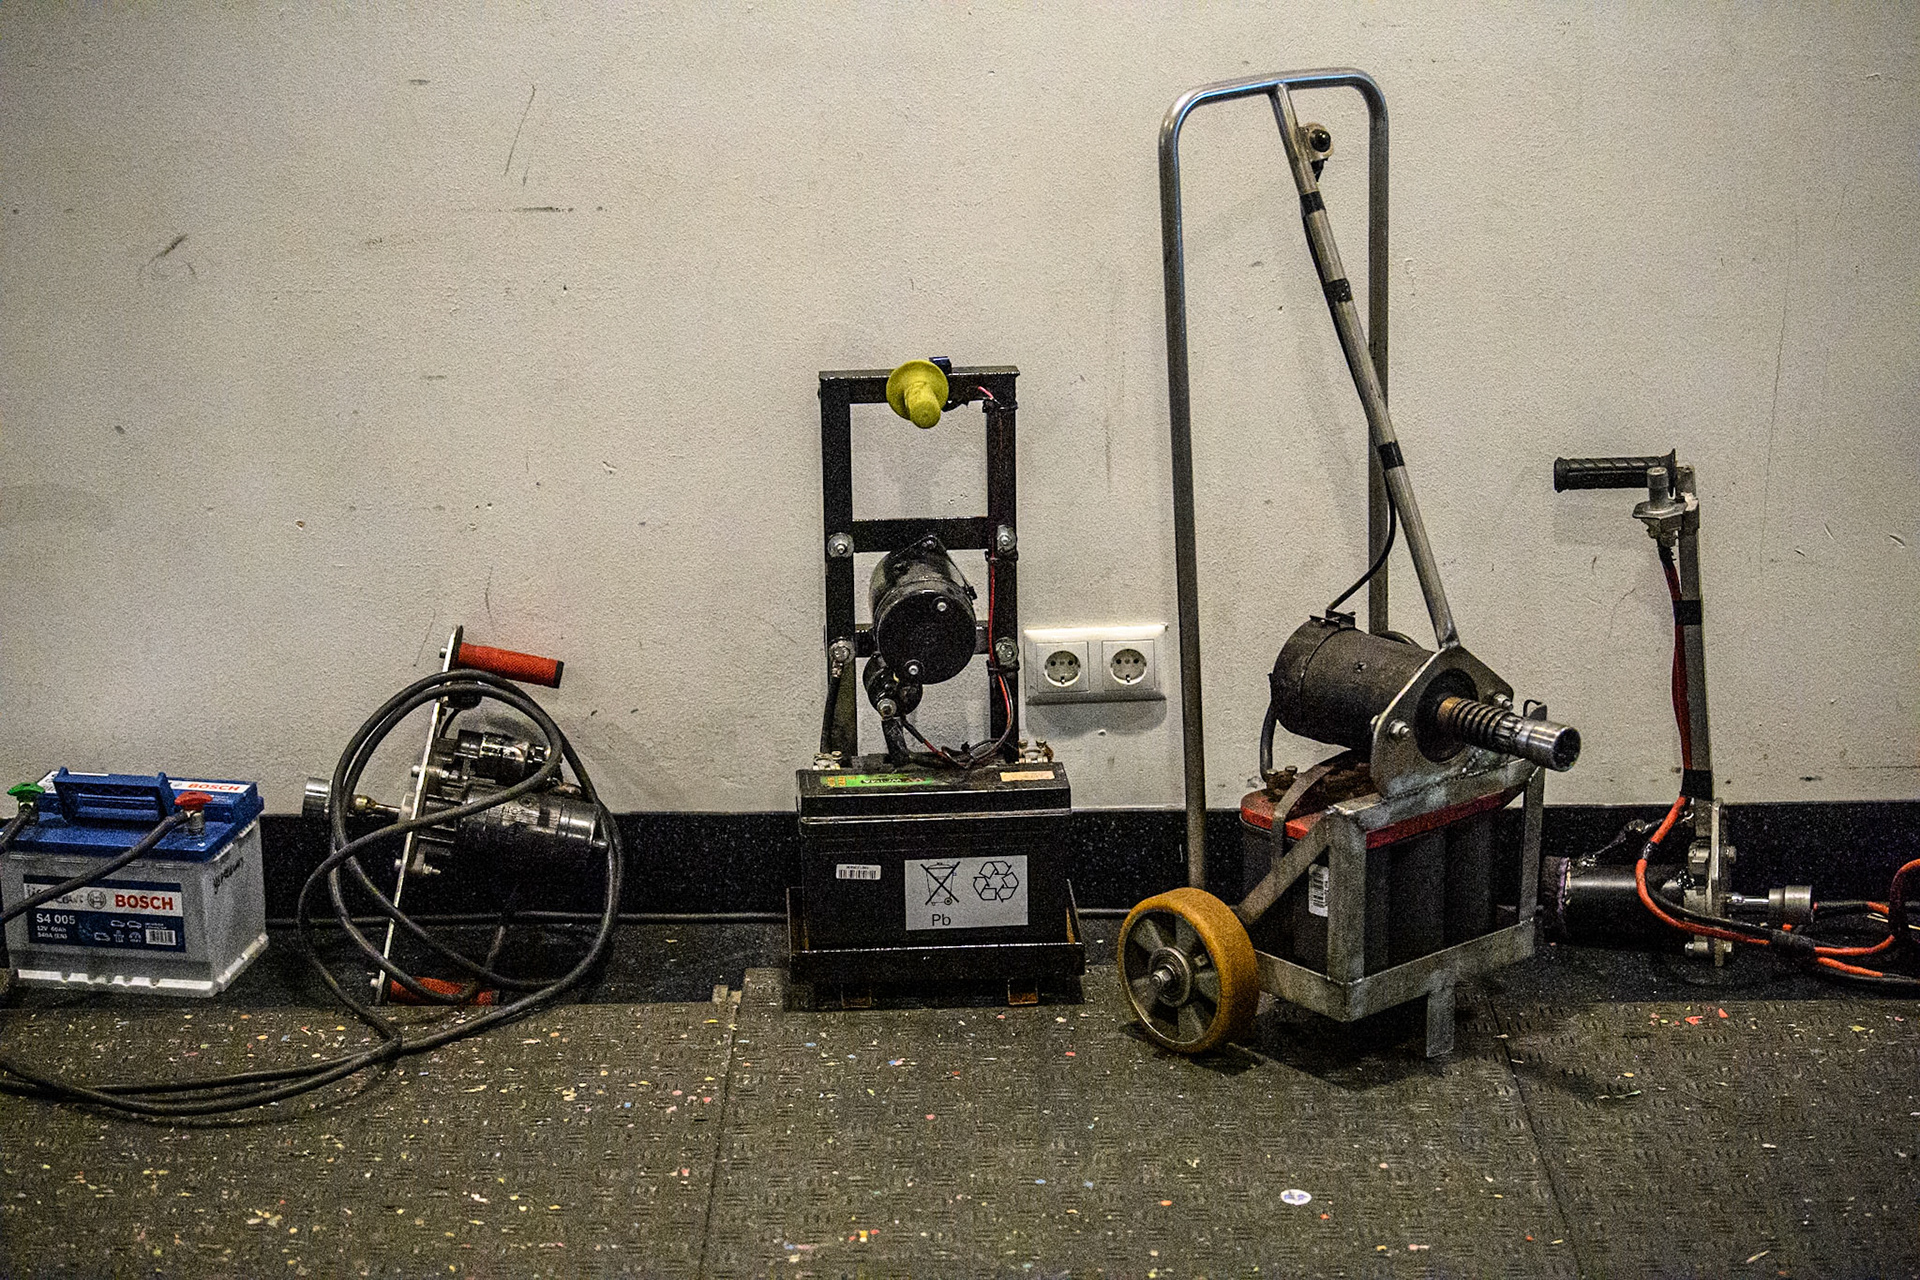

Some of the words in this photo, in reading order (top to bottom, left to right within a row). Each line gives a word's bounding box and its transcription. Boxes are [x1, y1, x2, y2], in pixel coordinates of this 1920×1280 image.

[187, 783, 241, 792] BOSCH
[114, 894, 174, 911] BOSCH
[36, 913, 52, 924] S4
[54, 914, 76, 925] 005
[931, 913, 952, 927] Pb
